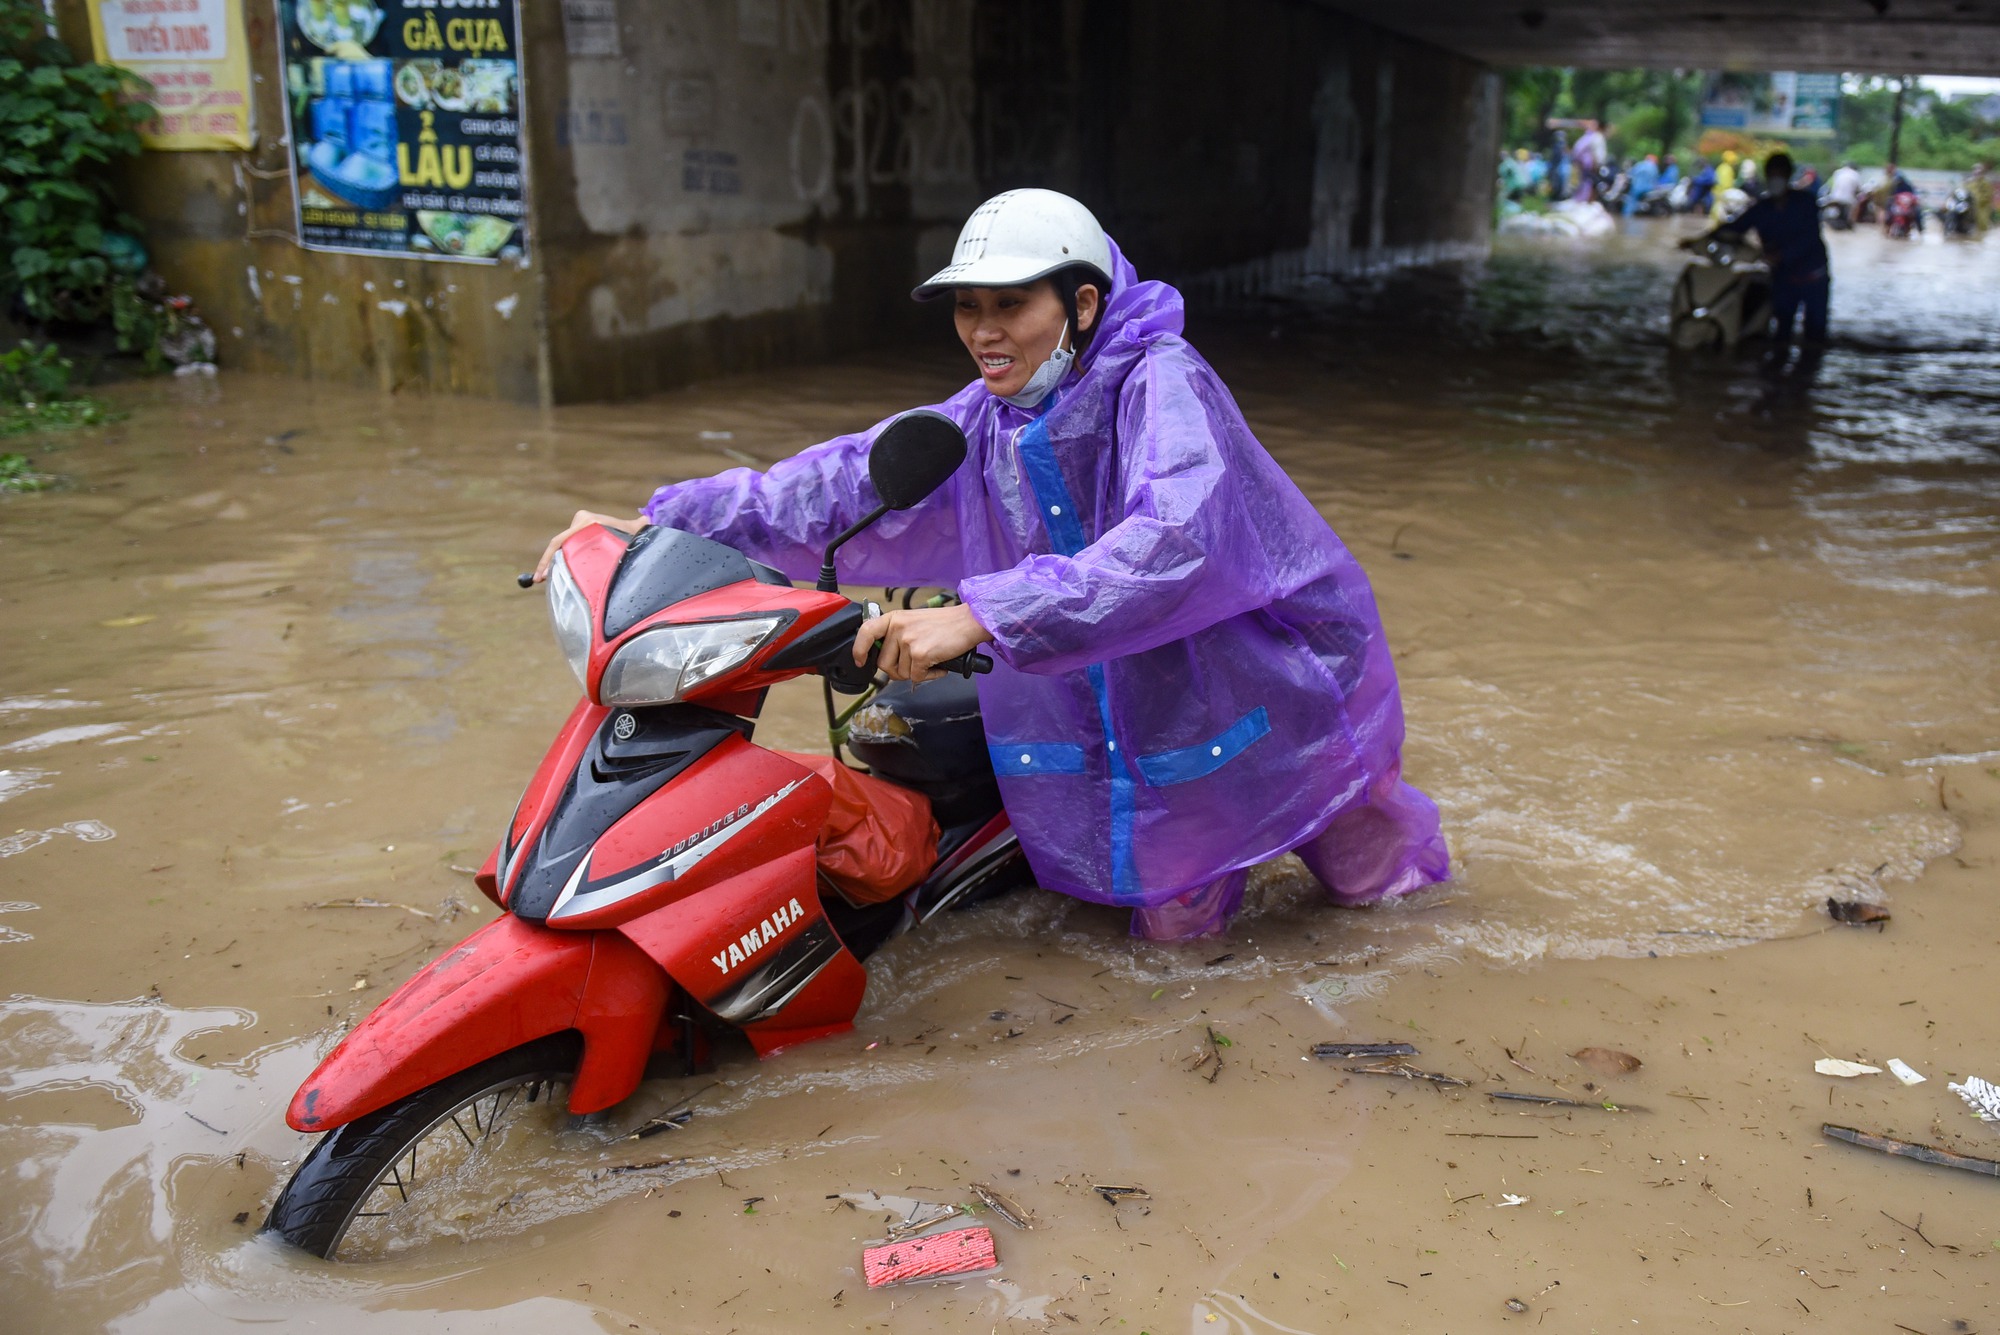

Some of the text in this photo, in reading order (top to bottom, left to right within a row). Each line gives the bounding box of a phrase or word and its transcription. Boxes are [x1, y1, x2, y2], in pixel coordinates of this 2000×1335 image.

[403, 9, 508, 58] GÀ CỰA
[397, 110, 473, 190] LẨU
[659, 803, 749, 862] JUPITER
[711, 897, 805, 975] YAMAHA
